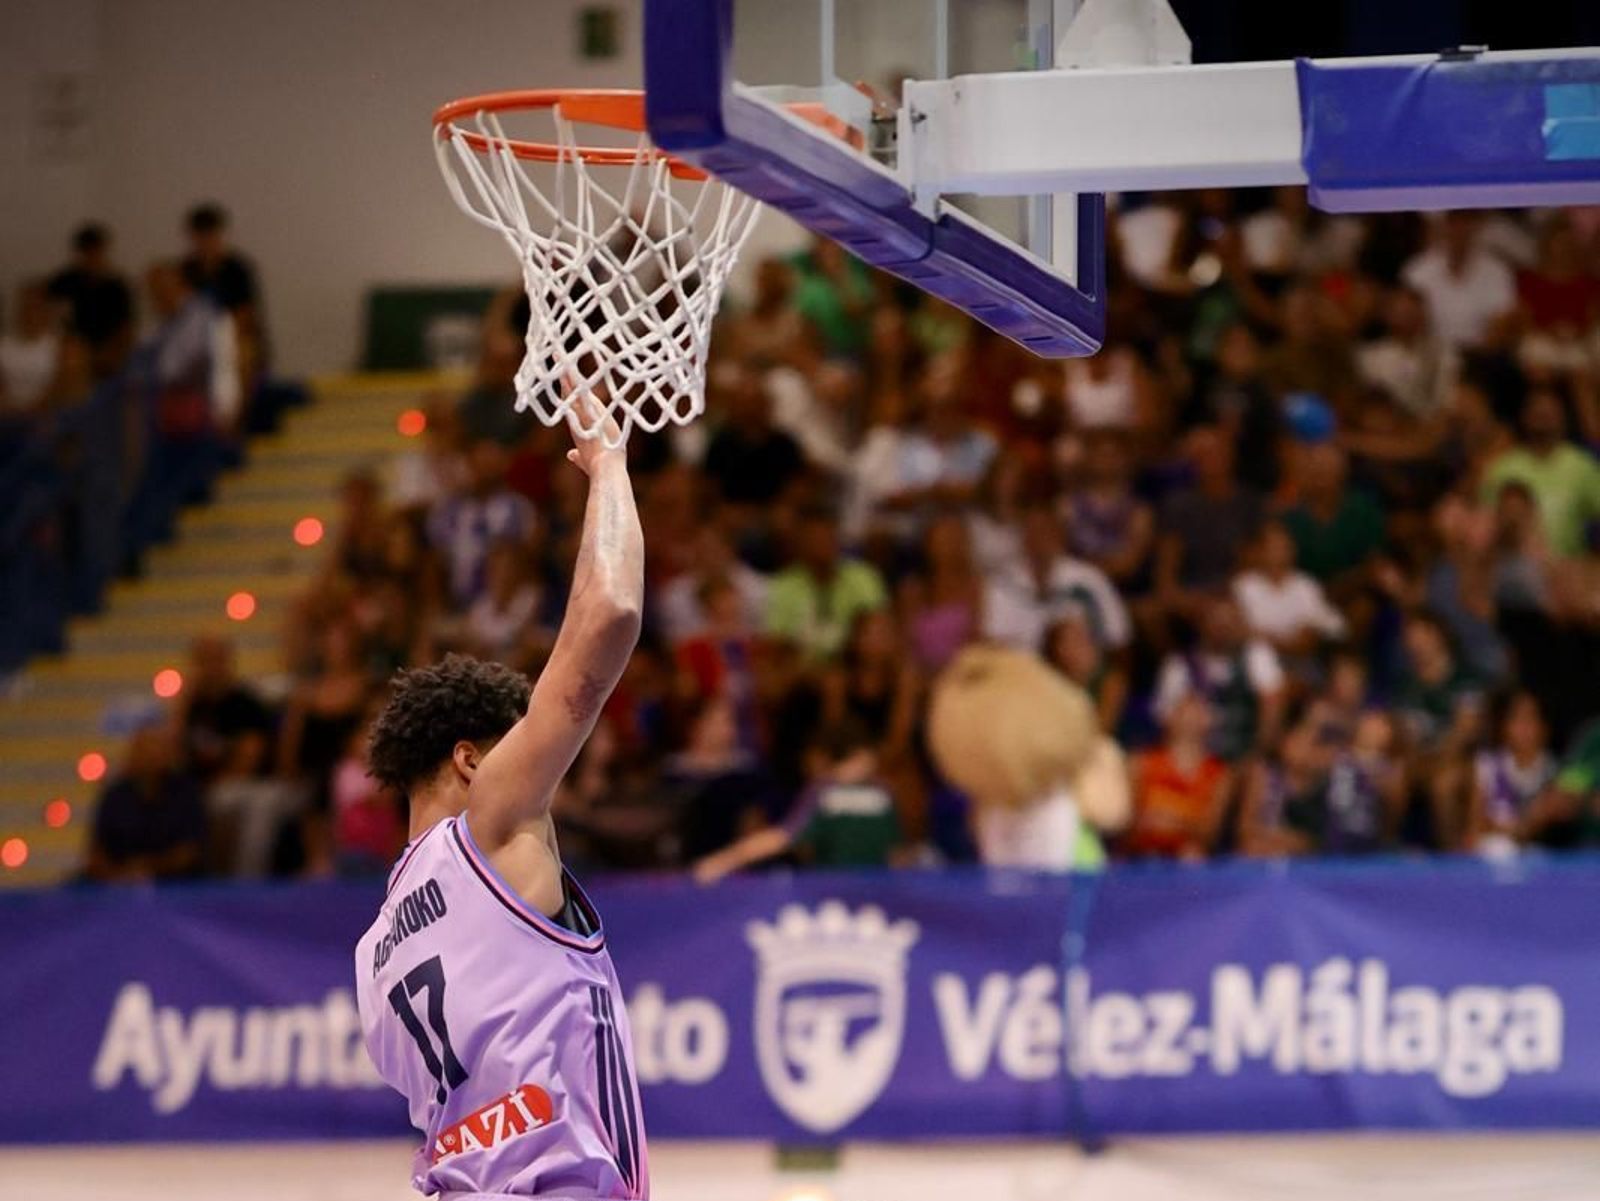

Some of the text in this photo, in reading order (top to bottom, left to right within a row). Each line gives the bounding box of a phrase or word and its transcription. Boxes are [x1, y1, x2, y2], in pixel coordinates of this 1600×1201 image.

[373, 878, 447, 980] AGAKOKO
[387, 954, 469, 1106] 17
[933, 957, 1564, 1098] Vélez-Málaga
